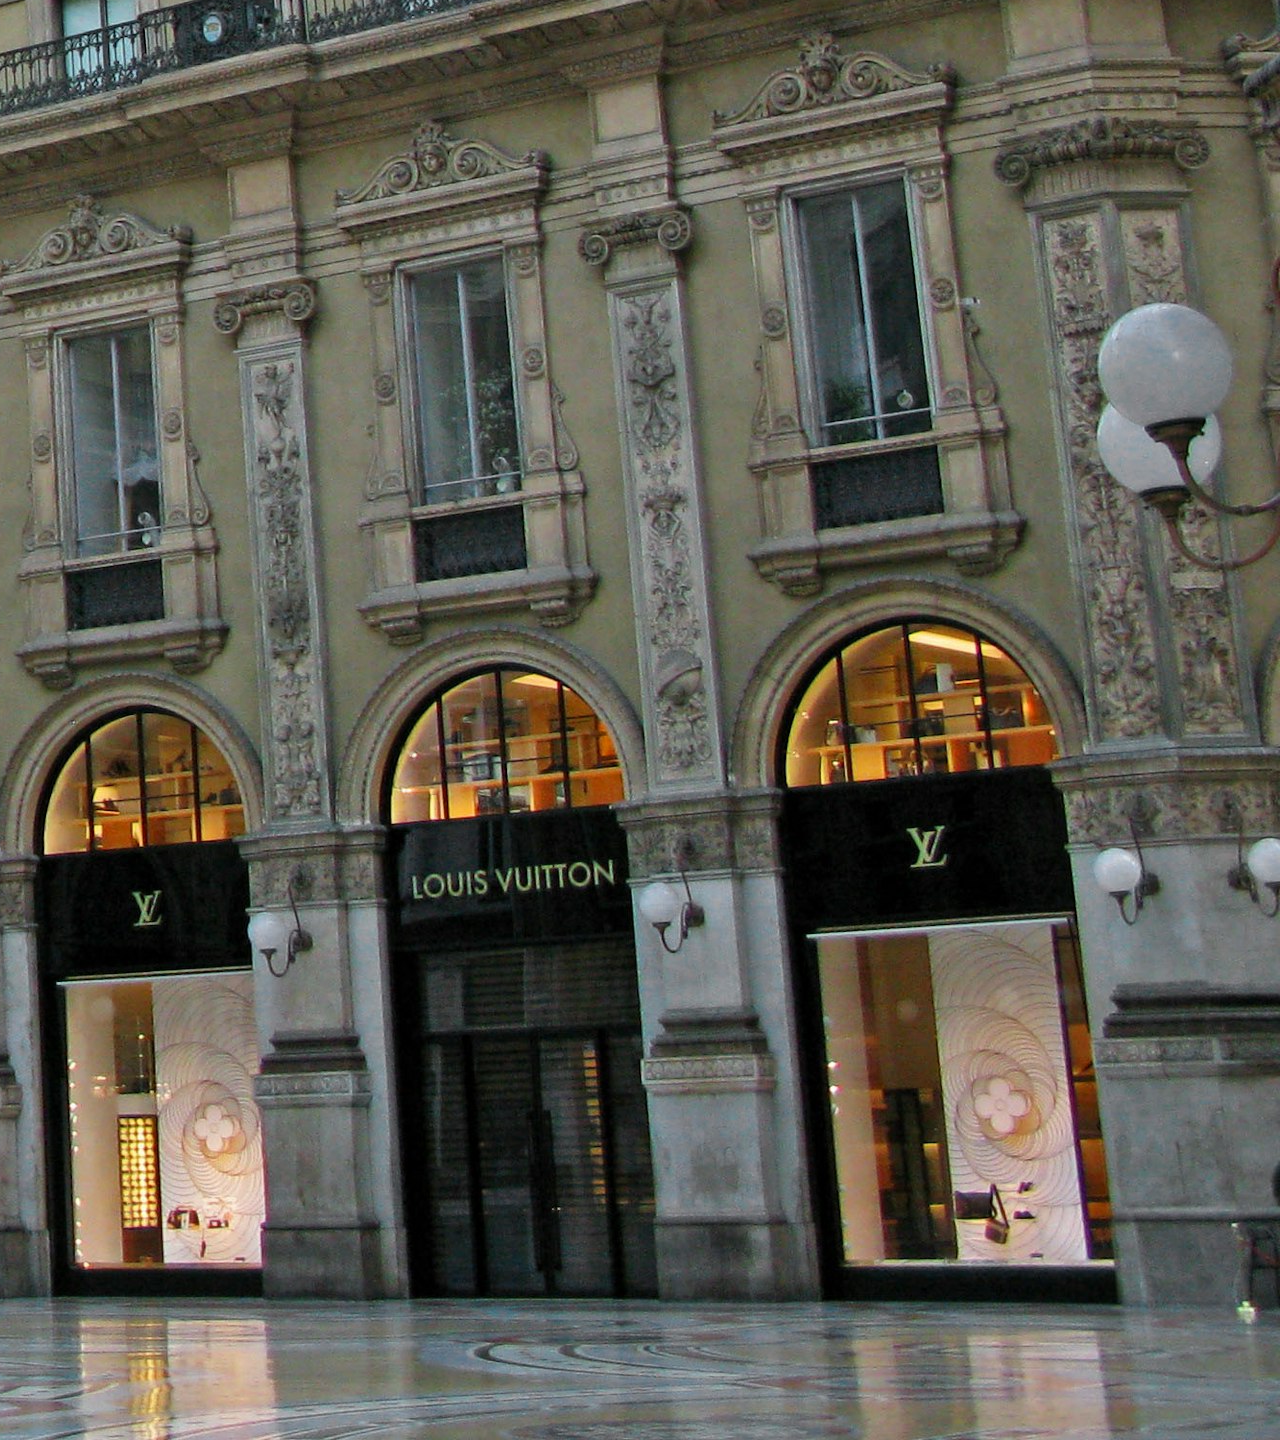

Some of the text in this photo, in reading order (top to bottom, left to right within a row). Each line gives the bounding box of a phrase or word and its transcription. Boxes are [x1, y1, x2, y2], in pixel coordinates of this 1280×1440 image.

[906, 825, 948, 868] LV
[411, 858, 616, 900] LOUIS VUITTON
[131, 889, 163, 928] LV
